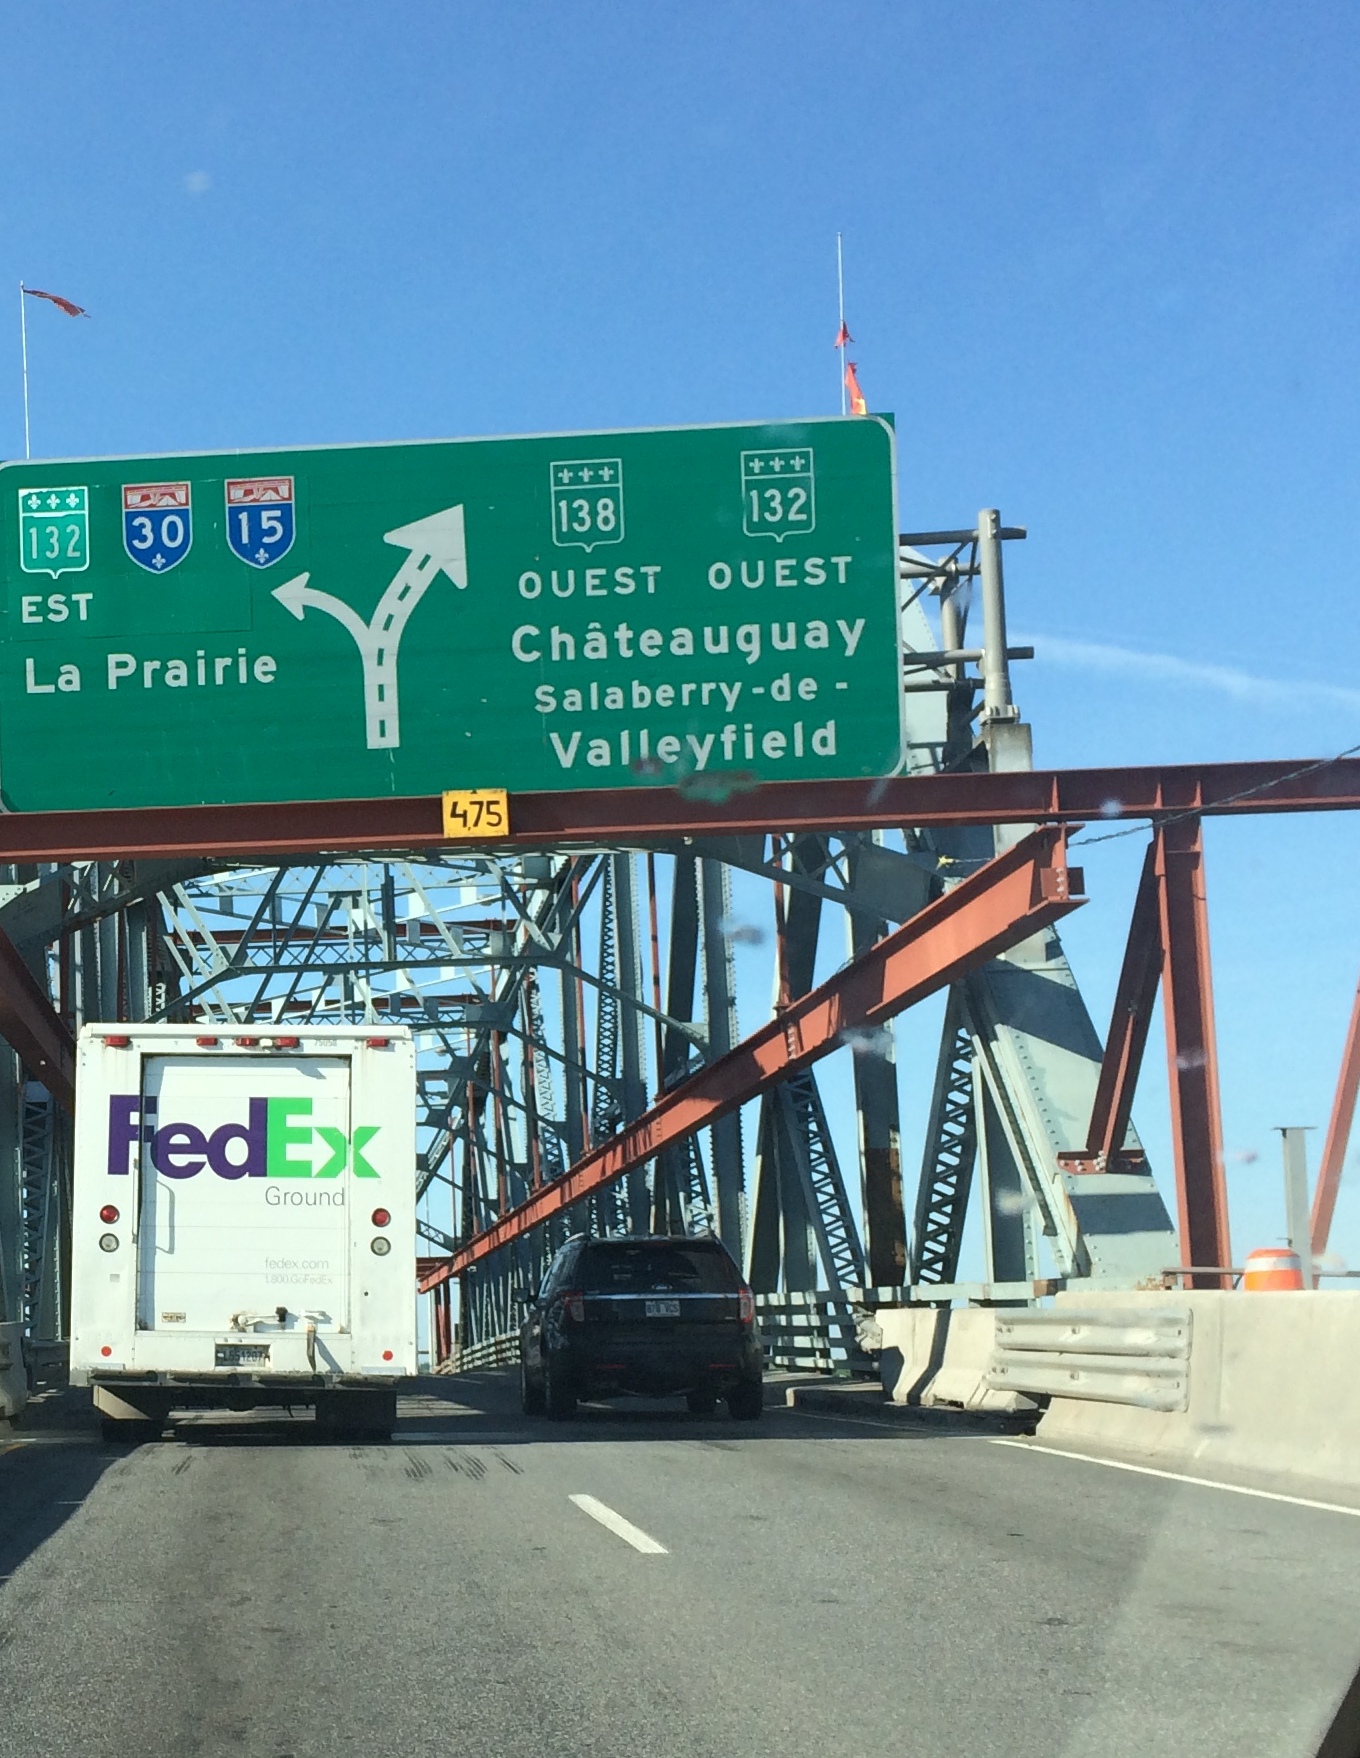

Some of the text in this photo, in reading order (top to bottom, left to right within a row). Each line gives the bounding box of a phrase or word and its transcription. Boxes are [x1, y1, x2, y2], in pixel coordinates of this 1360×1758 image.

[558, 498, 616, 533] 138
[750, 487, 808, 522] 132
[28, 525, 82, 560] 132
[131, 515, 185, 550] 30
[238, 509, 284, 545] 15
[518, 566, 662, 599] OUEST
[707, 556, 852, 590] OUEST
[21, 593, 93, 624] EST
[512, 618, 866, 665] Châteauguay
[25, 648, 278, 694] La Prairie
[549, 719, 837, 771] Valleyfield
[107, 1094, 382, 1180] FedEx
[264, 1186, 345, 1207] Ground
[265, 1257, 329, 1269] fedex.com
